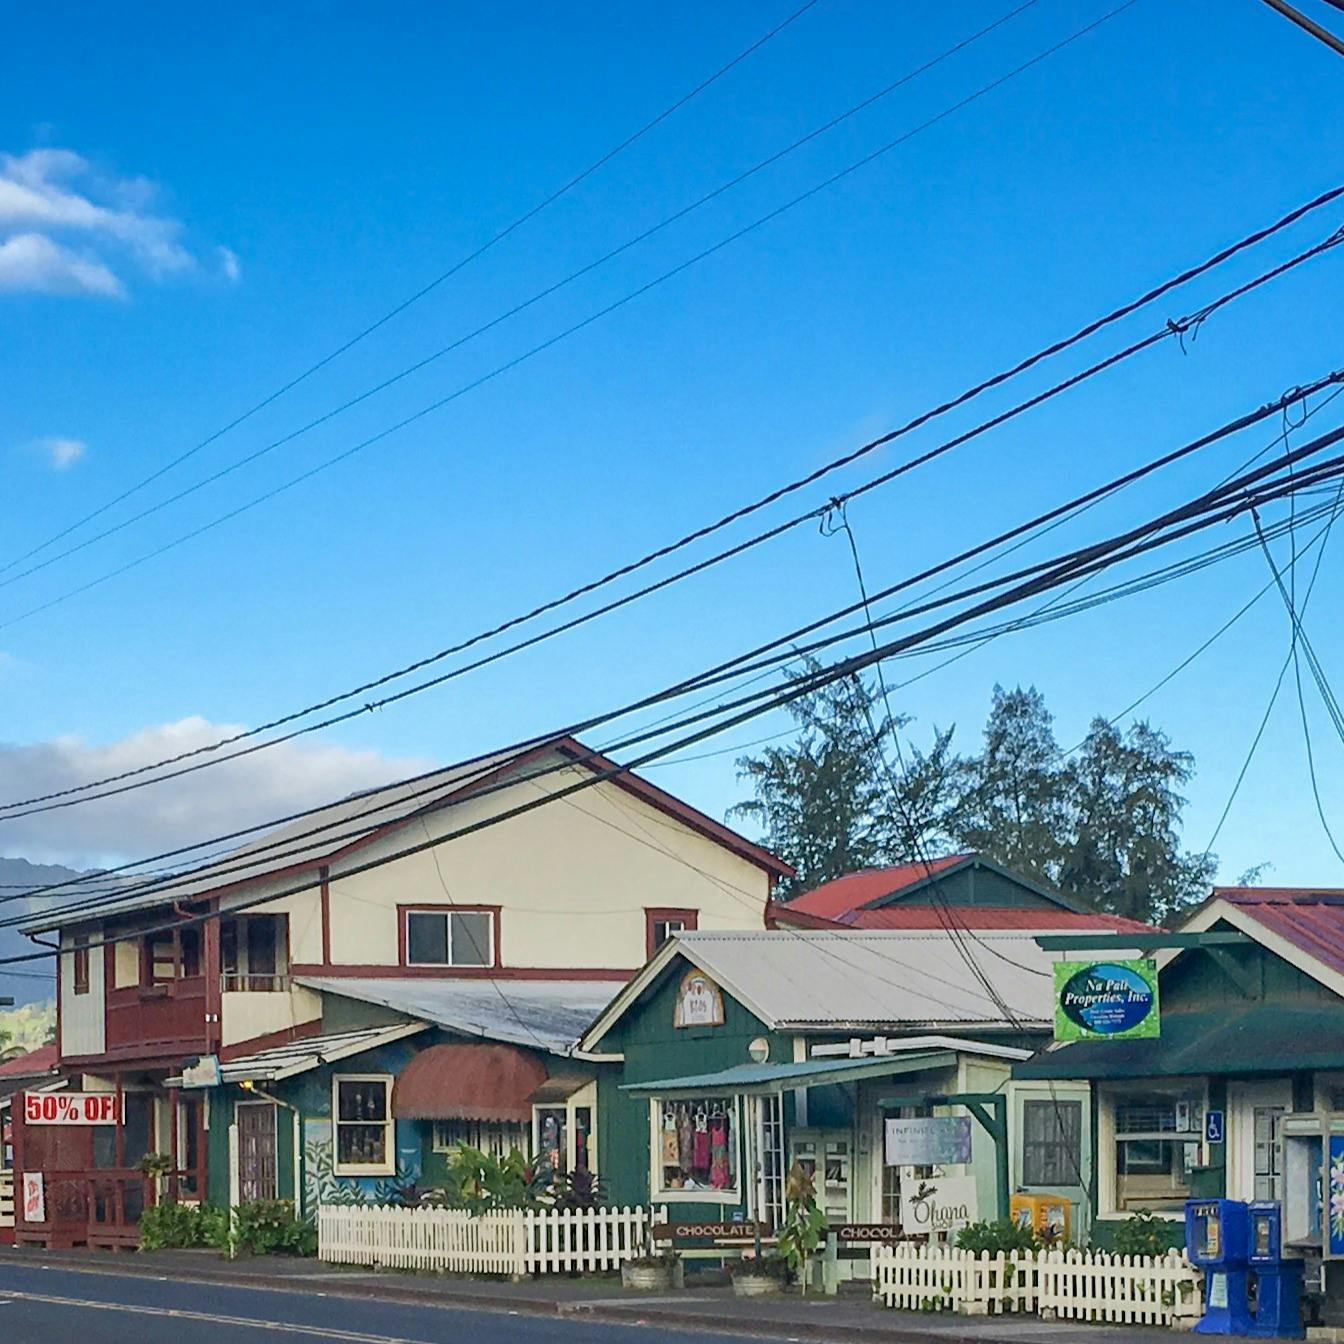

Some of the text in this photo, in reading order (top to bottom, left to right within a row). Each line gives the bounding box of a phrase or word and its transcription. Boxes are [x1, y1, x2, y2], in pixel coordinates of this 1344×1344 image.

[1085, 979, 1103, 992] Na
[1064, 990, 1149, 1007] Properties, Inc.
[26, 1095, 79, 1121] 50%
[914, 1199, 969, 1224] Ohana
[676, 1225, 754, 1236] CHOCOLATE
[840, 1227, 924, 1239] CHOCOL
